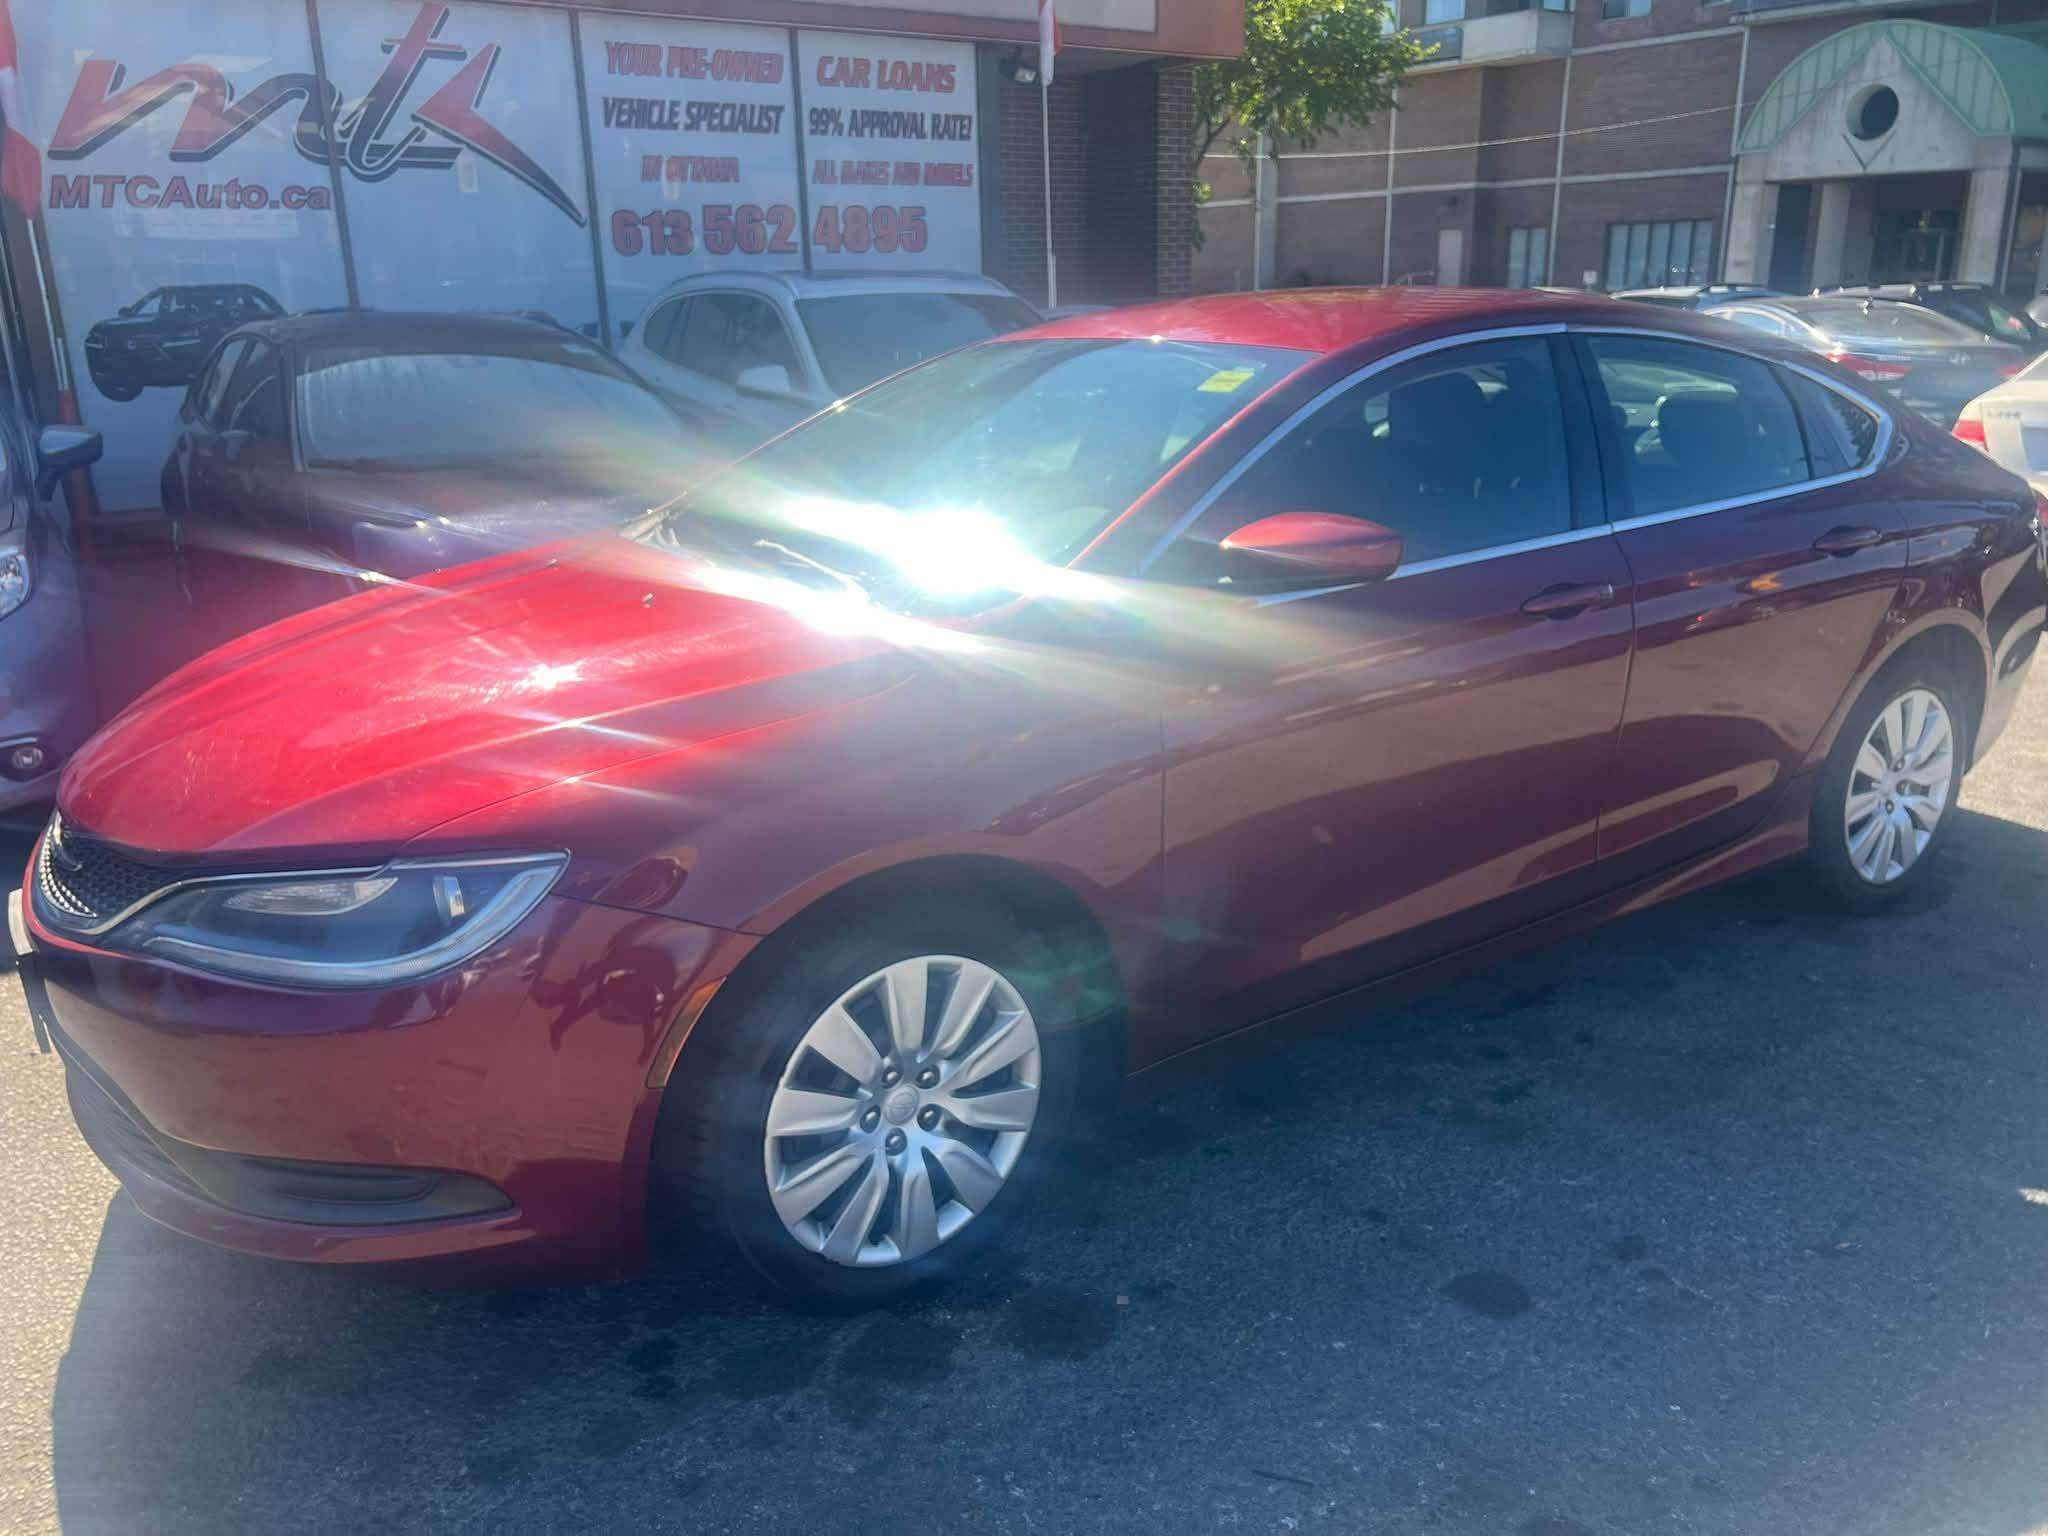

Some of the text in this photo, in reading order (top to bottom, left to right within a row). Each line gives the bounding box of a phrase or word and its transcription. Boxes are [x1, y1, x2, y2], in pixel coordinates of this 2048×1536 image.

[604, 41, 785, 84] YOUR PRE-OWNED
[817, 55, 957, 93] CAR LOANS
[602, 97, 785, 134] VEHICLE SPECIALIST
[809, 106, 845, 137] 99%
[847, 109, 929, 140] APPROVAL
[49, 174, 331, 210] MTCAuto.ca
[611, 204, 929, 256] 613 562 4895
